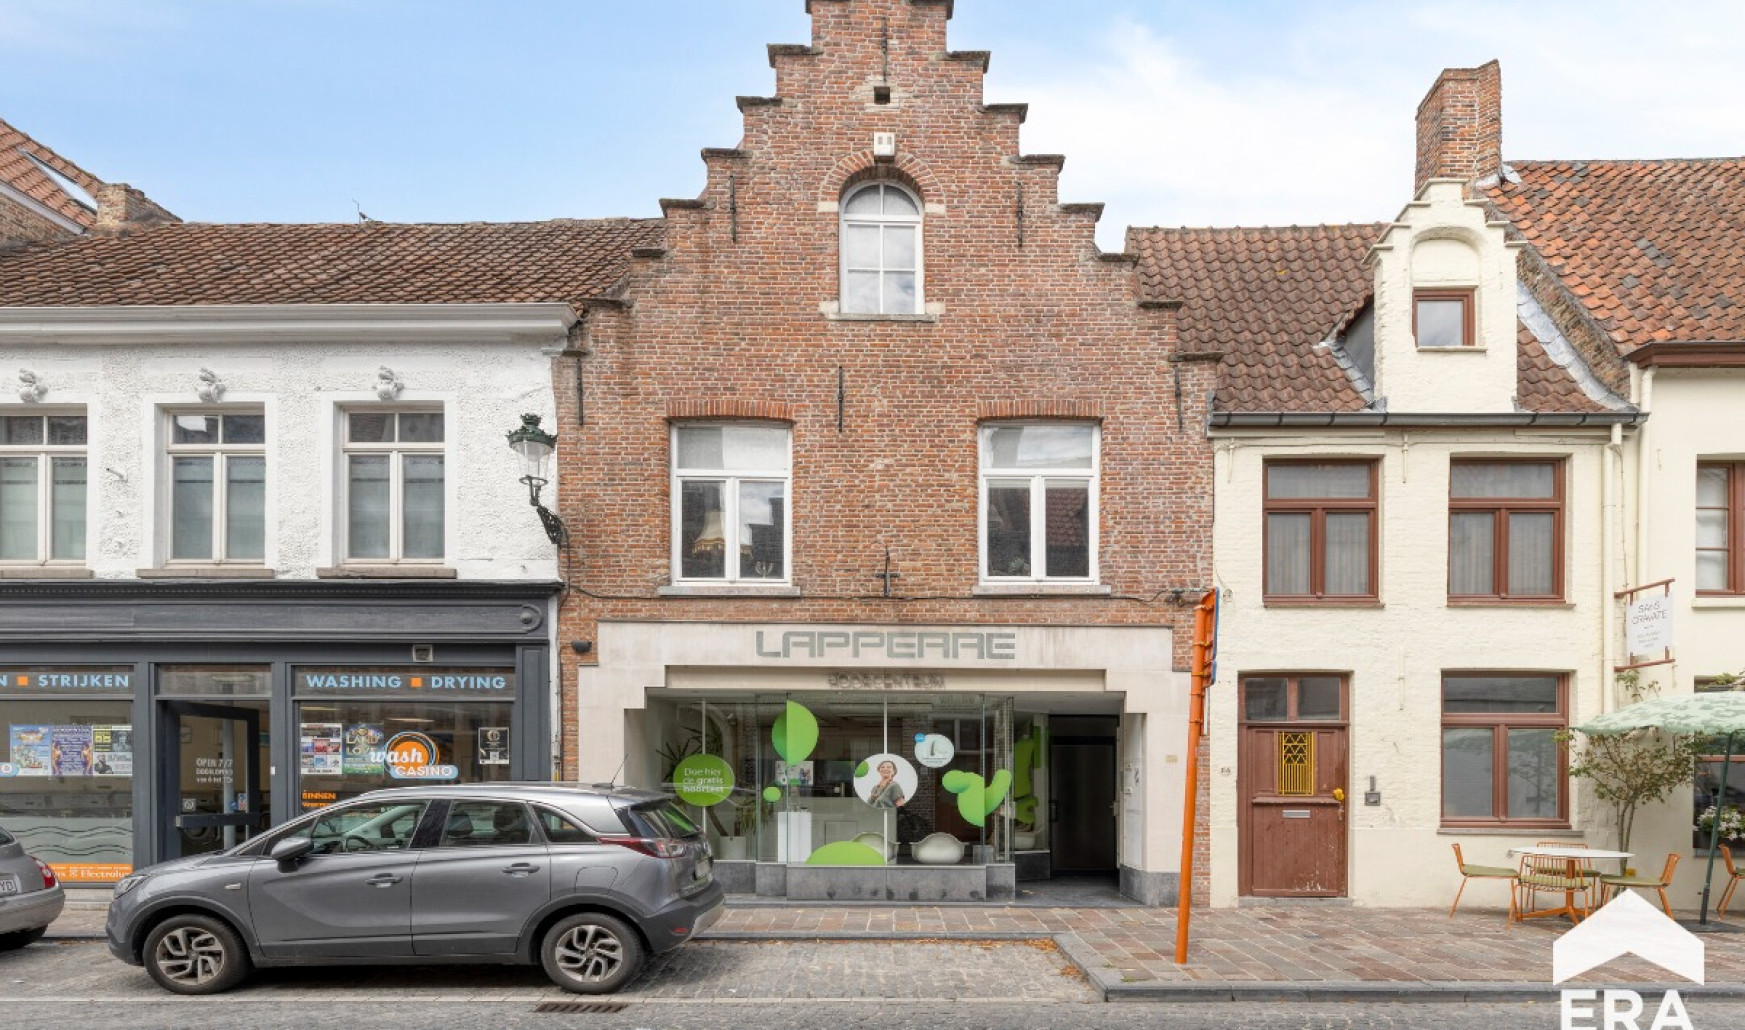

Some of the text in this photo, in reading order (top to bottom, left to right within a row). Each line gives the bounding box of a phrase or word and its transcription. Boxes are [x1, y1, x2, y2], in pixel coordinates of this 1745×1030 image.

[38, 674, 129, 687] STRIJKEN
[306, 675, 506, 689] WASHING DRYING
[370, 747, 424, 764] wash
[395, 766, 453, 776] CASINO
[684, 767, 721, 776] Doe hier
[696, 777, 724, 787] gratis
